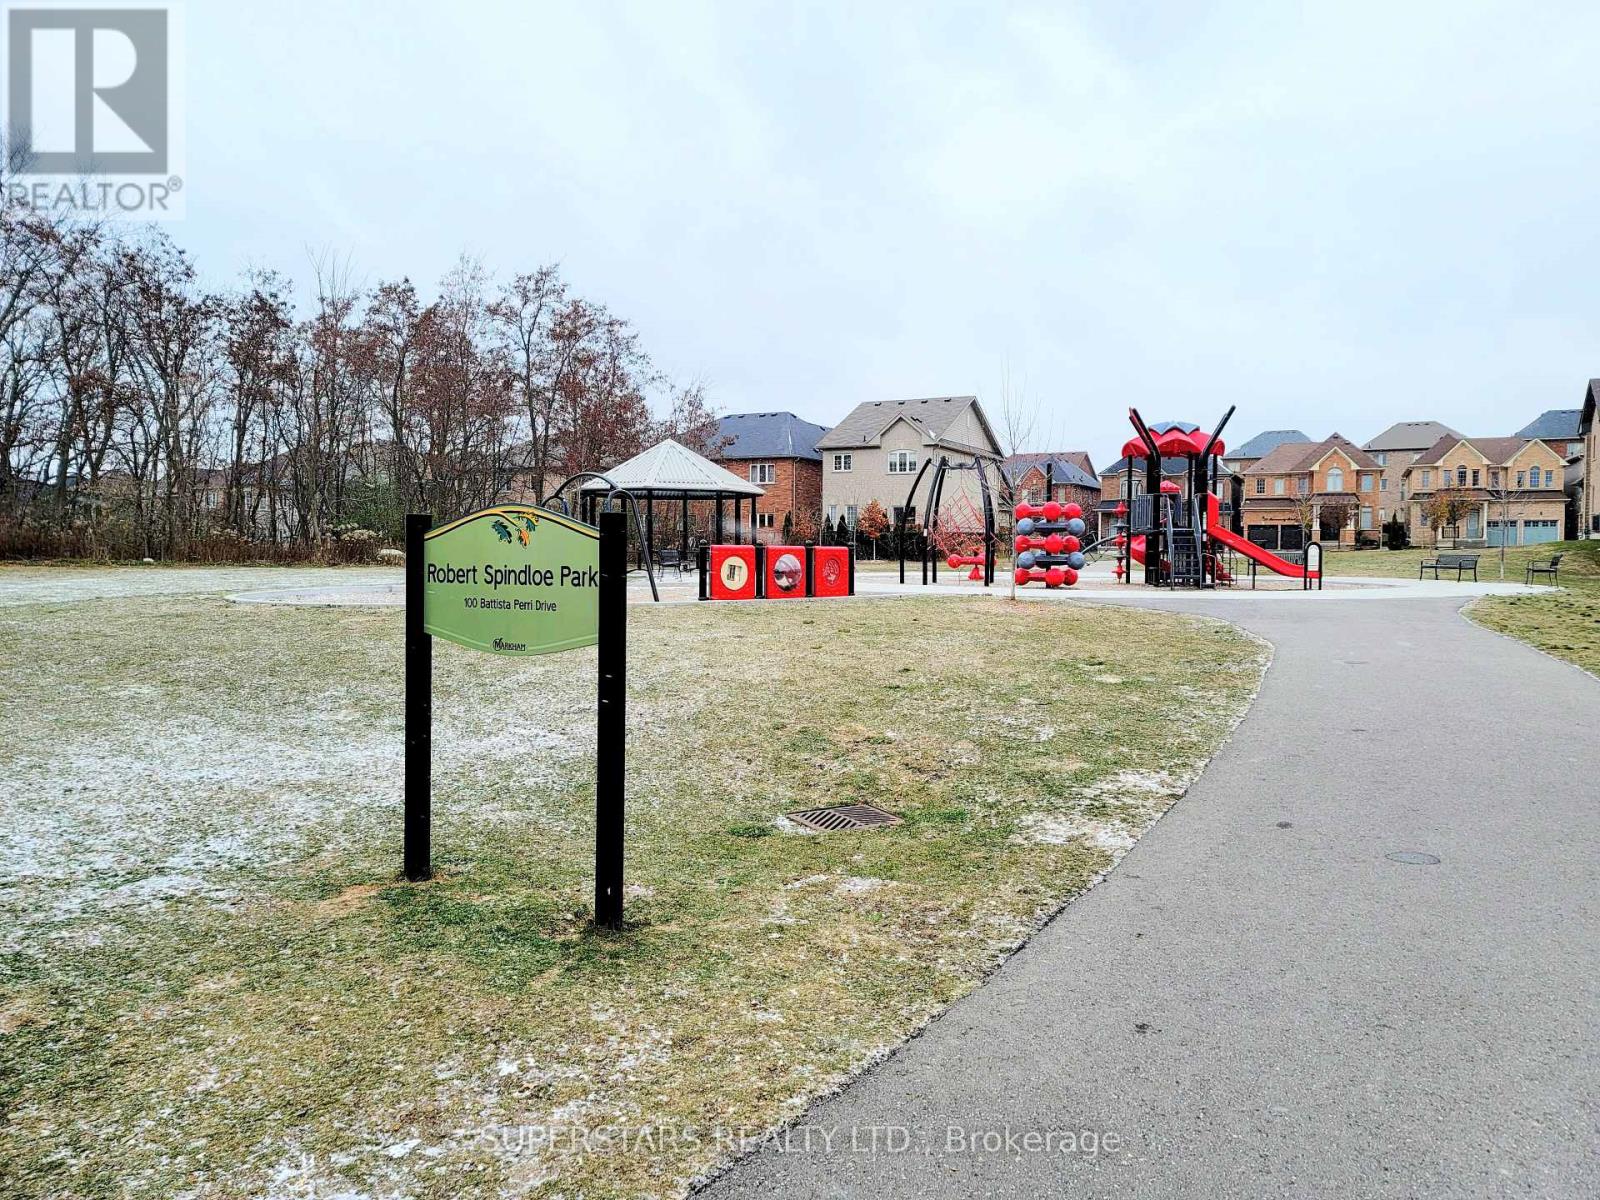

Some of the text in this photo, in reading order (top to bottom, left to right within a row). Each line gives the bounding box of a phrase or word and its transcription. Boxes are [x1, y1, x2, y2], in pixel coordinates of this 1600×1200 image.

[427, 563, 598, 590] Robert Spindloe Park
[464, 597, 557, 612] 100 Battista Perri Drive
